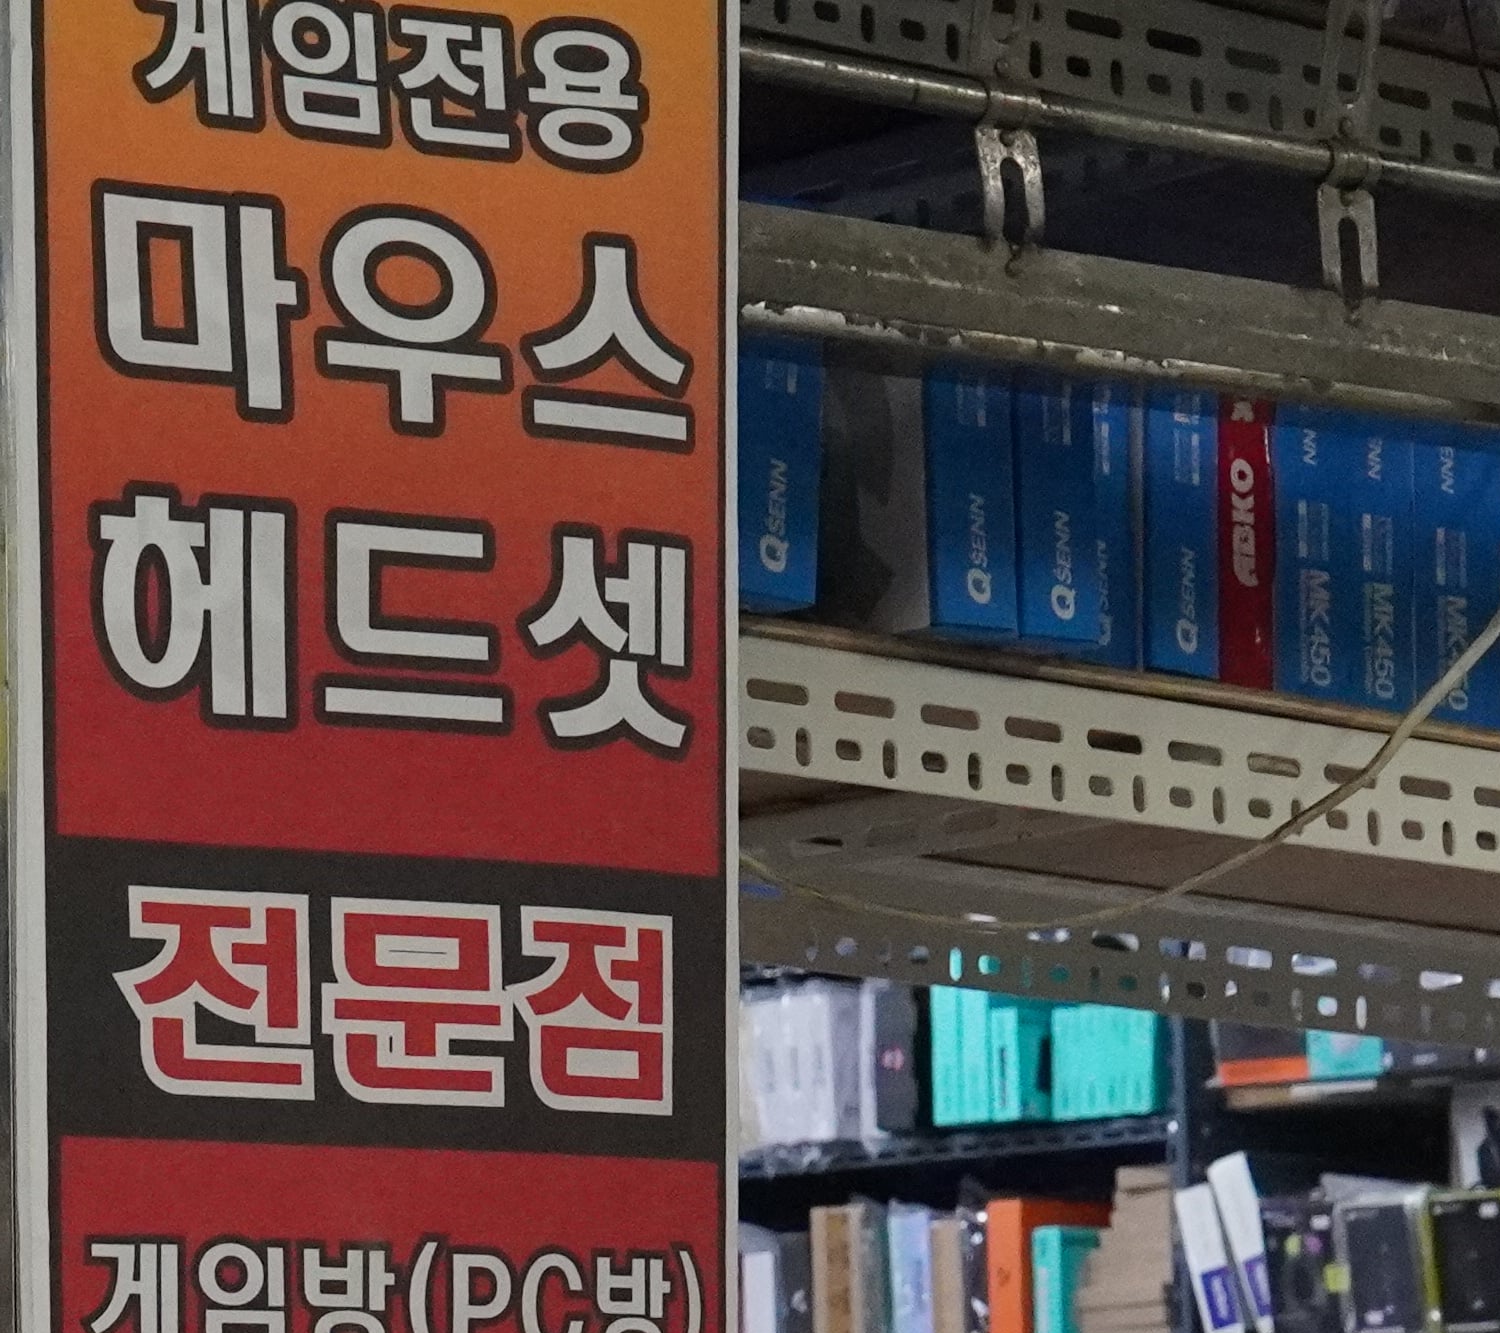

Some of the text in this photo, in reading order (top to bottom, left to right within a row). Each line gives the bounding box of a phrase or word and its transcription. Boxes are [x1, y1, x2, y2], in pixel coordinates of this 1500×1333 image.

[140, 0, 645, 168] 게임전용
[96, 182, 694, 448] 마우스
[759, 457, 790, 573] QSENN
[967, 492, 993, 604] QSENN
[1050, 509, 1077, 621] QSENN
[93, 488, 694, 756] 헤드셋
[1304, 568, 1331, 688] MK450
[1372, 582, 1395, 700] MK450
[112, 884, 674, 1116] 전문점
